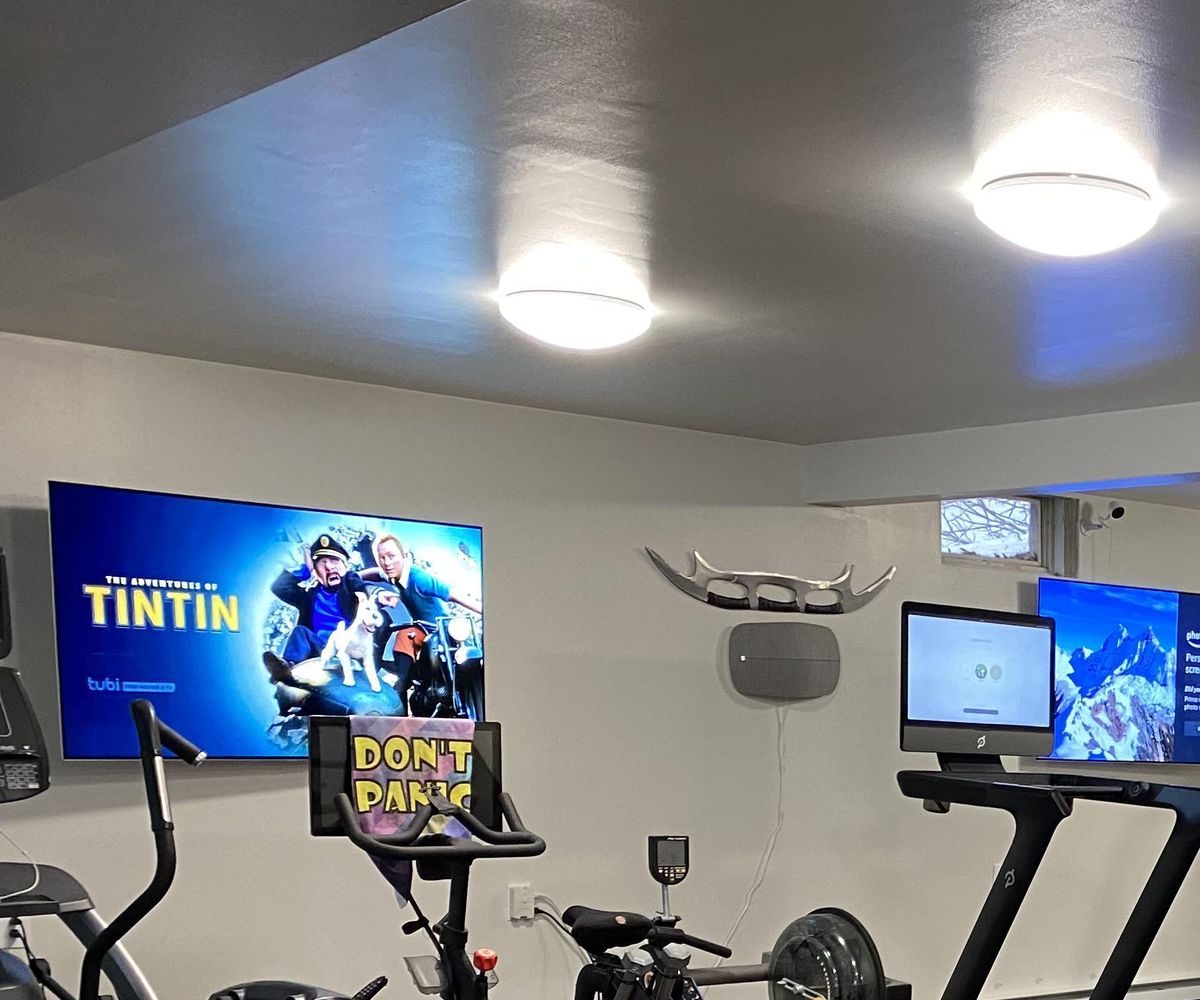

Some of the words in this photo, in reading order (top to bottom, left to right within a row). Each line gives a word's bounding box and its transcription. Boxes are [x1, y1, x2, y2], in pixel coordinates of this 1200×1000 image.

[105, 575, 127, 585] THE
[131, 577, 201, 590] ADVENTURES
[204, 582, 218, 591] OF
[83, 584, 240, 632] TINTIN
[87, 676, 120, 691] tubi
[353, 735, 472, 773] DON'T
